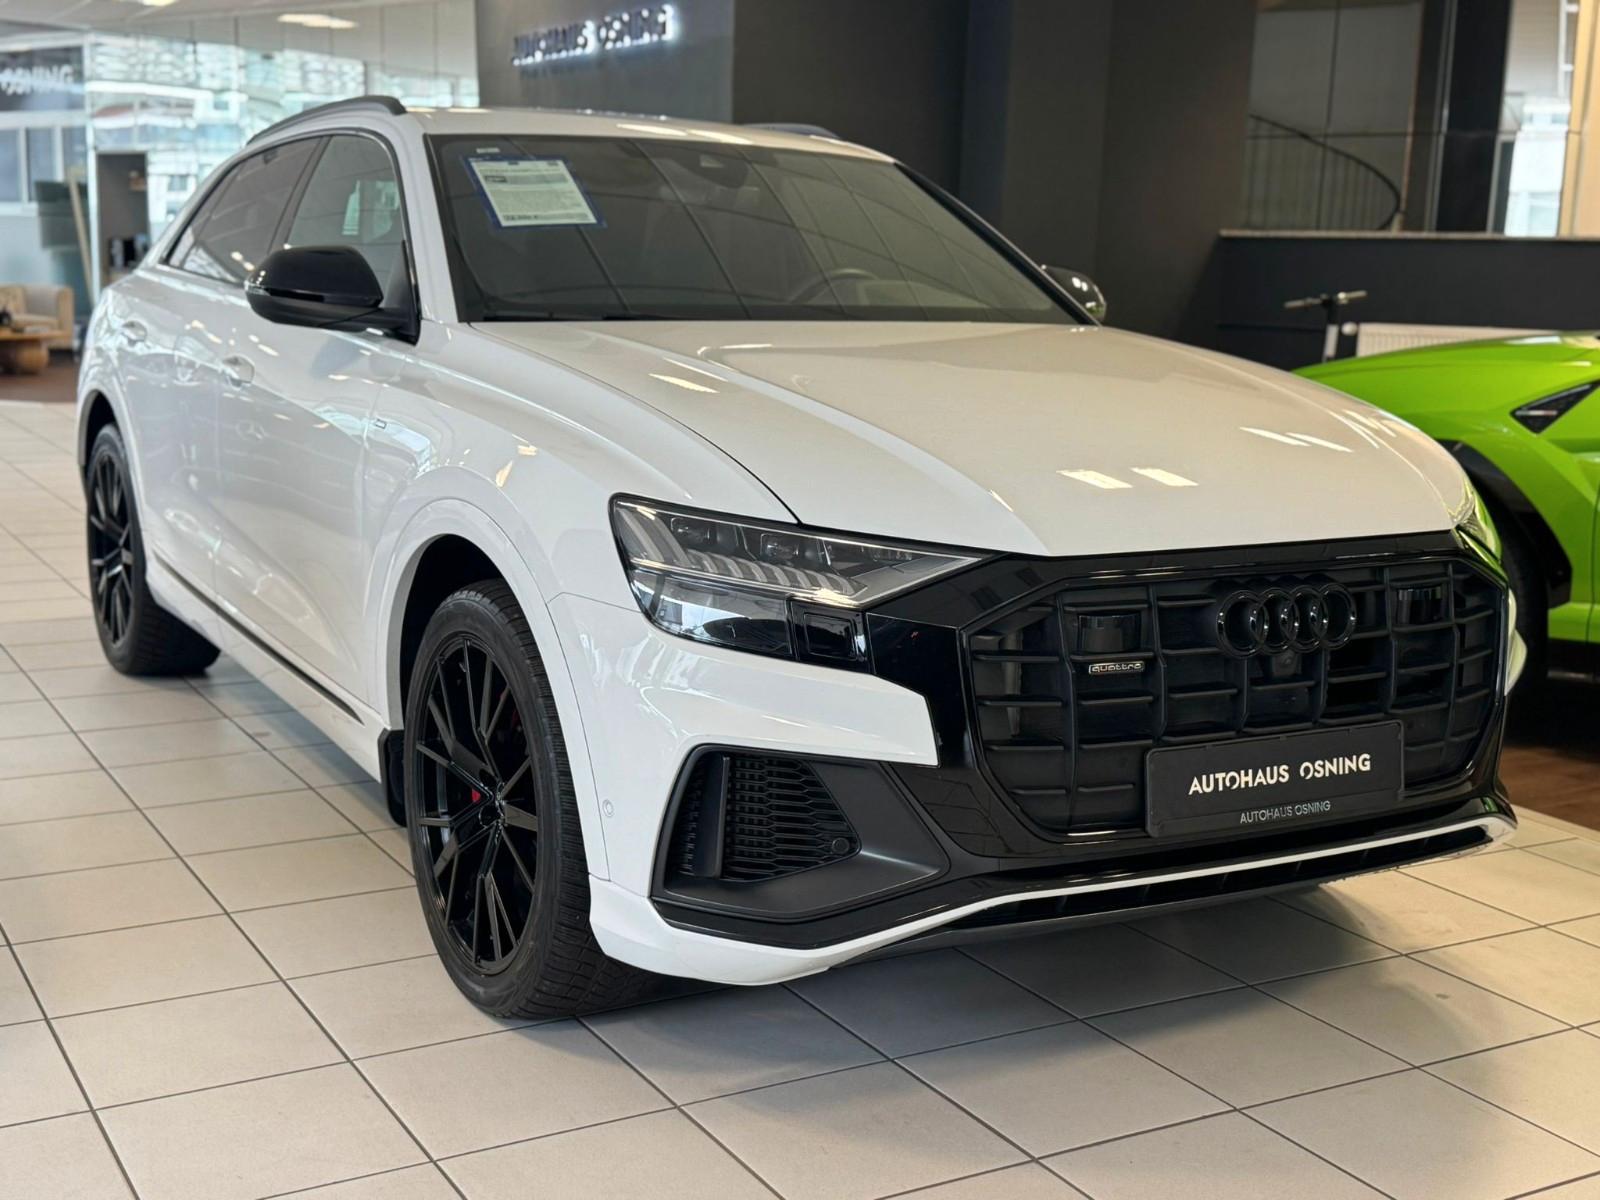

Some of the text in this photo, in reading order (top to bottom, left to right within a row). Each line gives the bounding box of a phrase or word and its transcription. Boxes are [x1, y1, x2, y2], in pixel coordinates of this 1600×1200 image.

[1091, 663, 1142, 673] quattro
[1188, 753, 1371, 795] AUTOHAUS OSNING
[1239, 800, 1331, 824] AUTOHAUS OSNING
